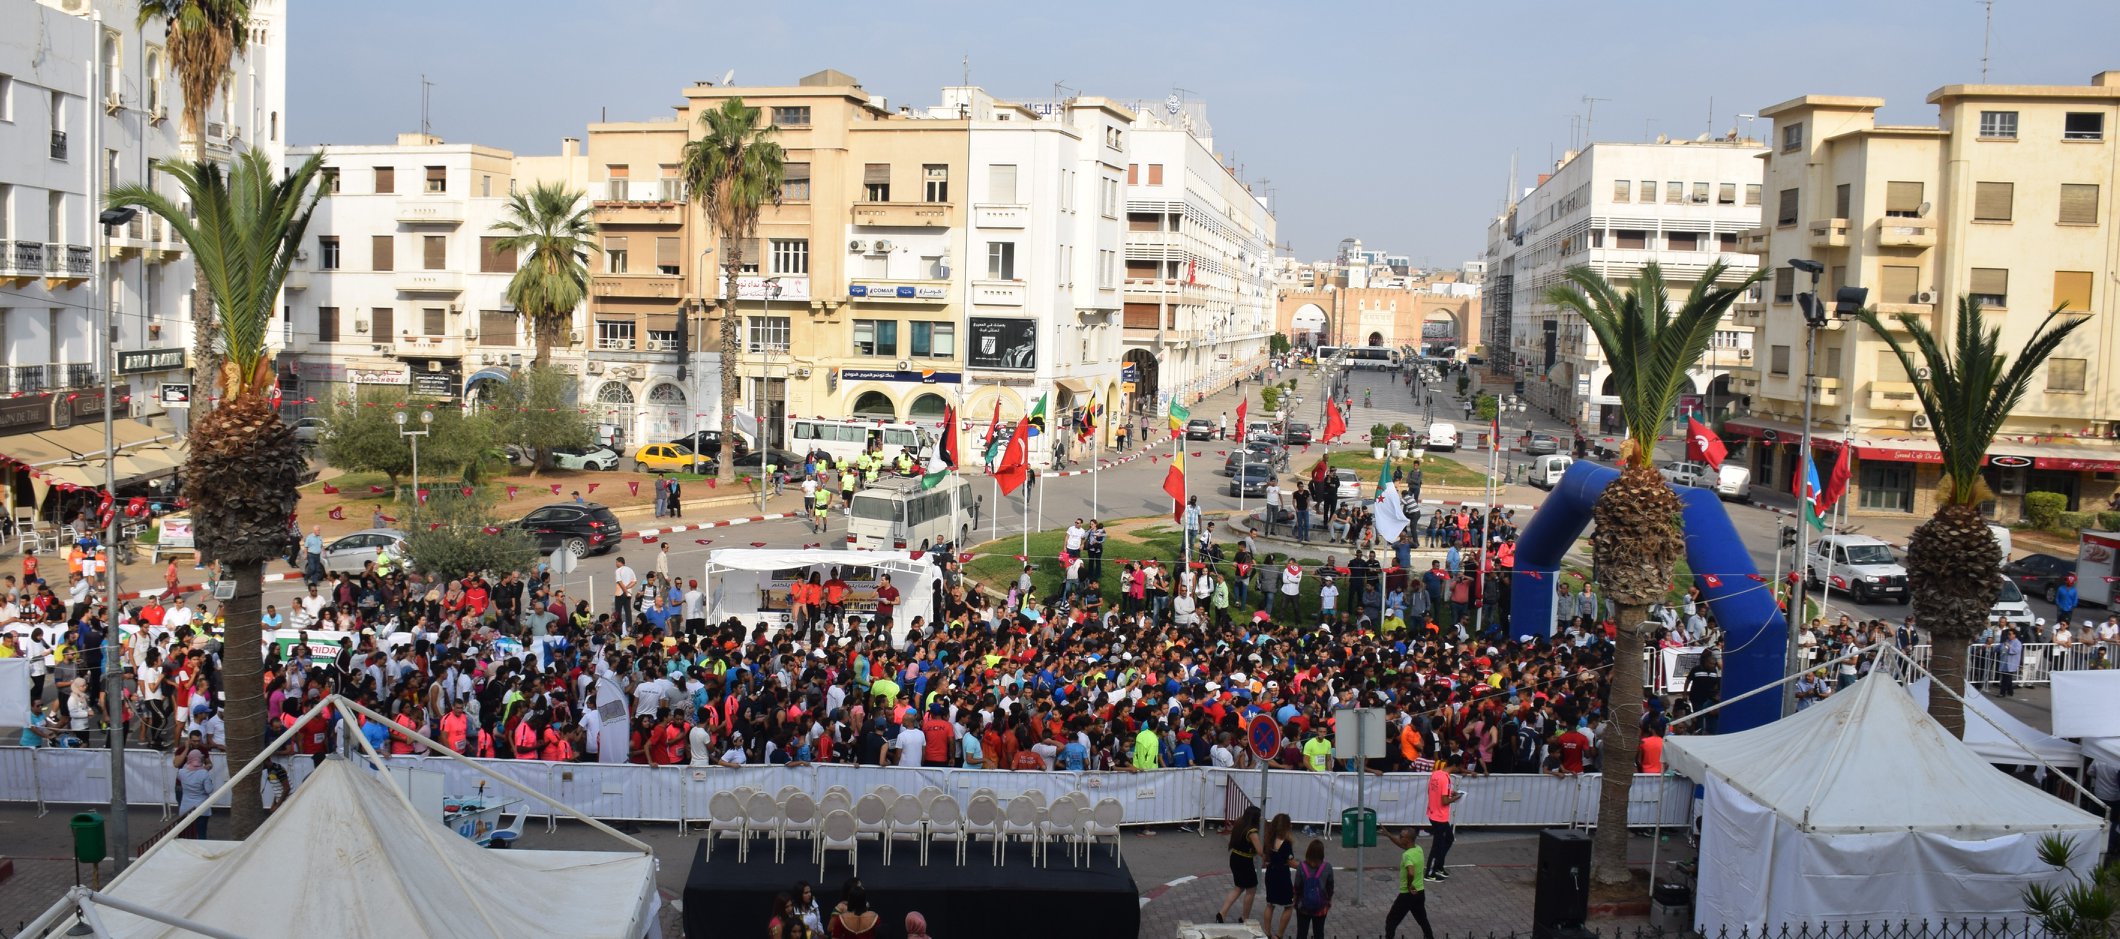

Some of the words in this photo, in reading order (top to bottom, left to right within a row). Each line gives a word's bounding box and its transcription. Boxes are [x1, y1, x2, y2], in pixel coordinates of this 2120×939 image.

[150, 352, 182, 367] BANK
[1894, 451, 1911, 459] Grand
[1519, 736, 1526, 749] 7
